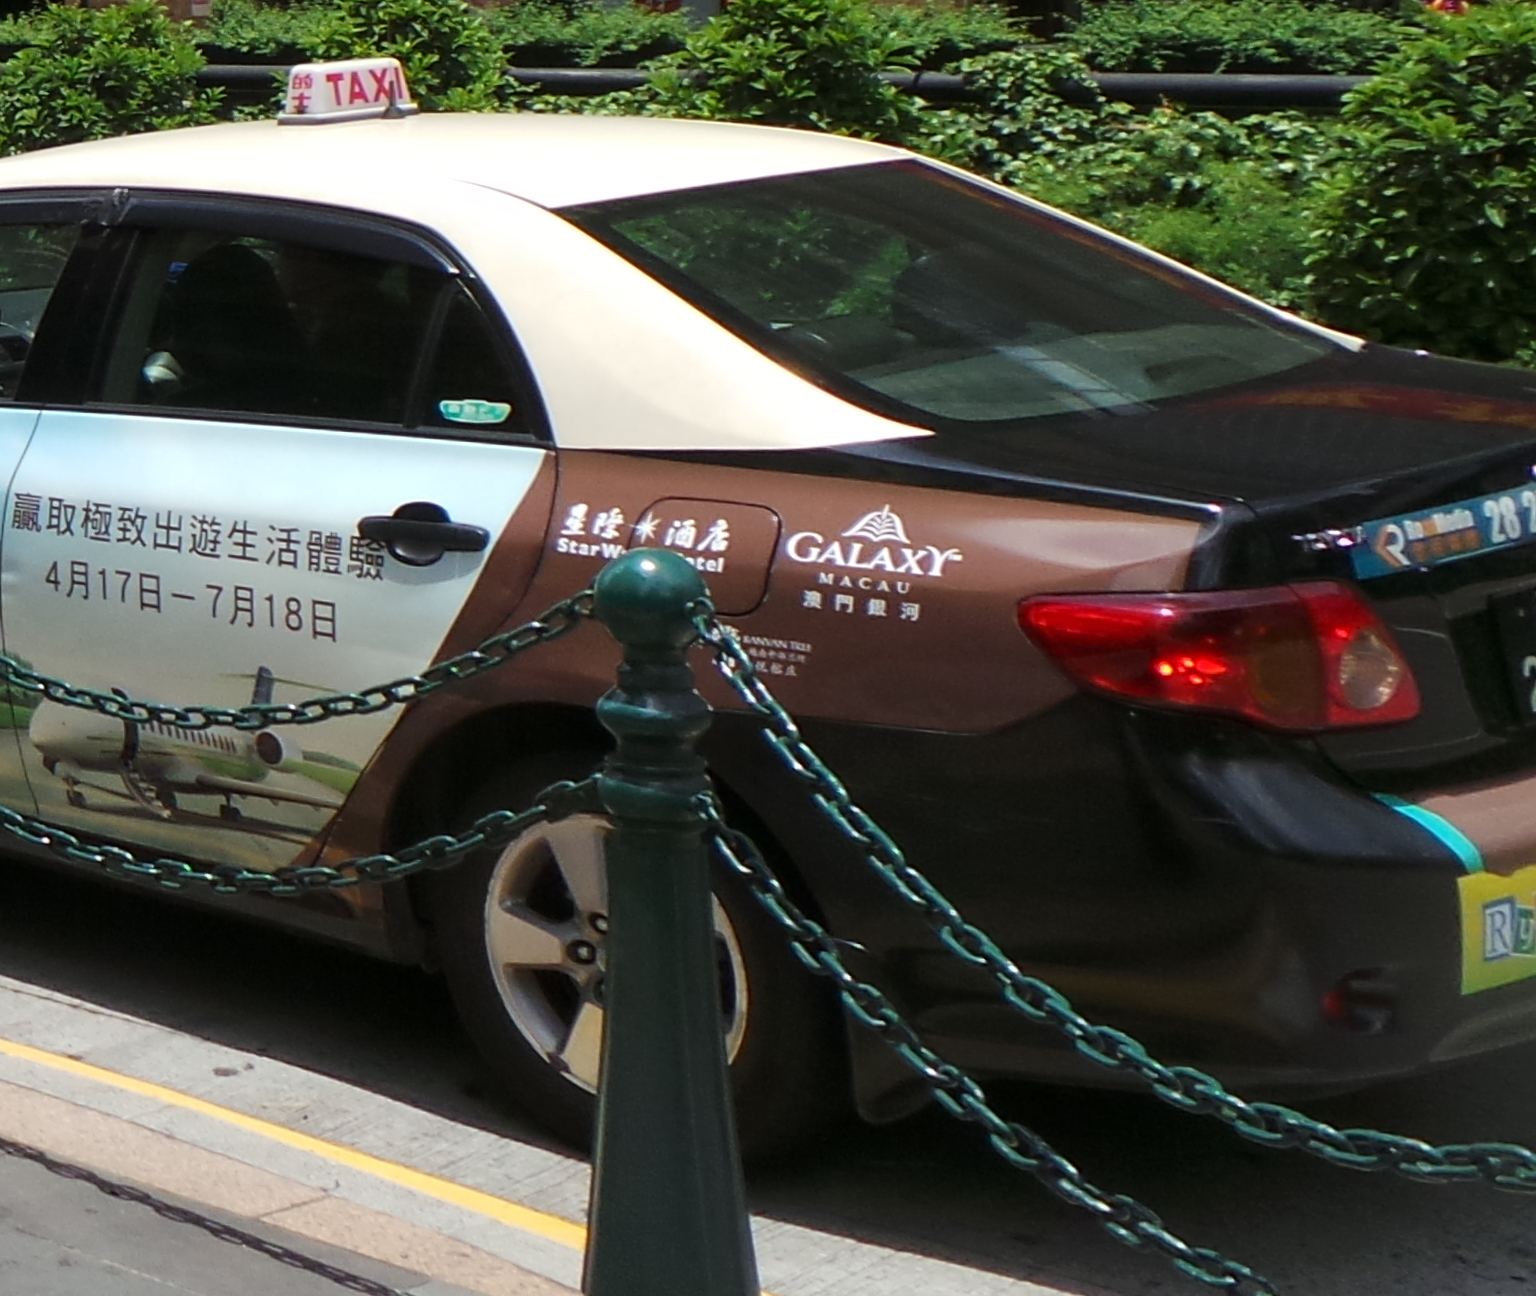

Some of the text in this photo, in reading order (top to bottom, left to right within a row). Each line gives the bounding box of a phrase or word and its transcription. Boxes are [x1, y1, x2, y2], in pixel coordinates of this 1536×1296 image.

[326, 66, 404, 106] TAXI
[11, 492, 386, 581] 贏取極致出遊生活體驗
[664, 519, 730, 552] 酒店
[787, 532, 958, 578] GALAXY
[818, 572, 912, 595] MACAU
[801, 589, 921, 623] 澳門銀河
